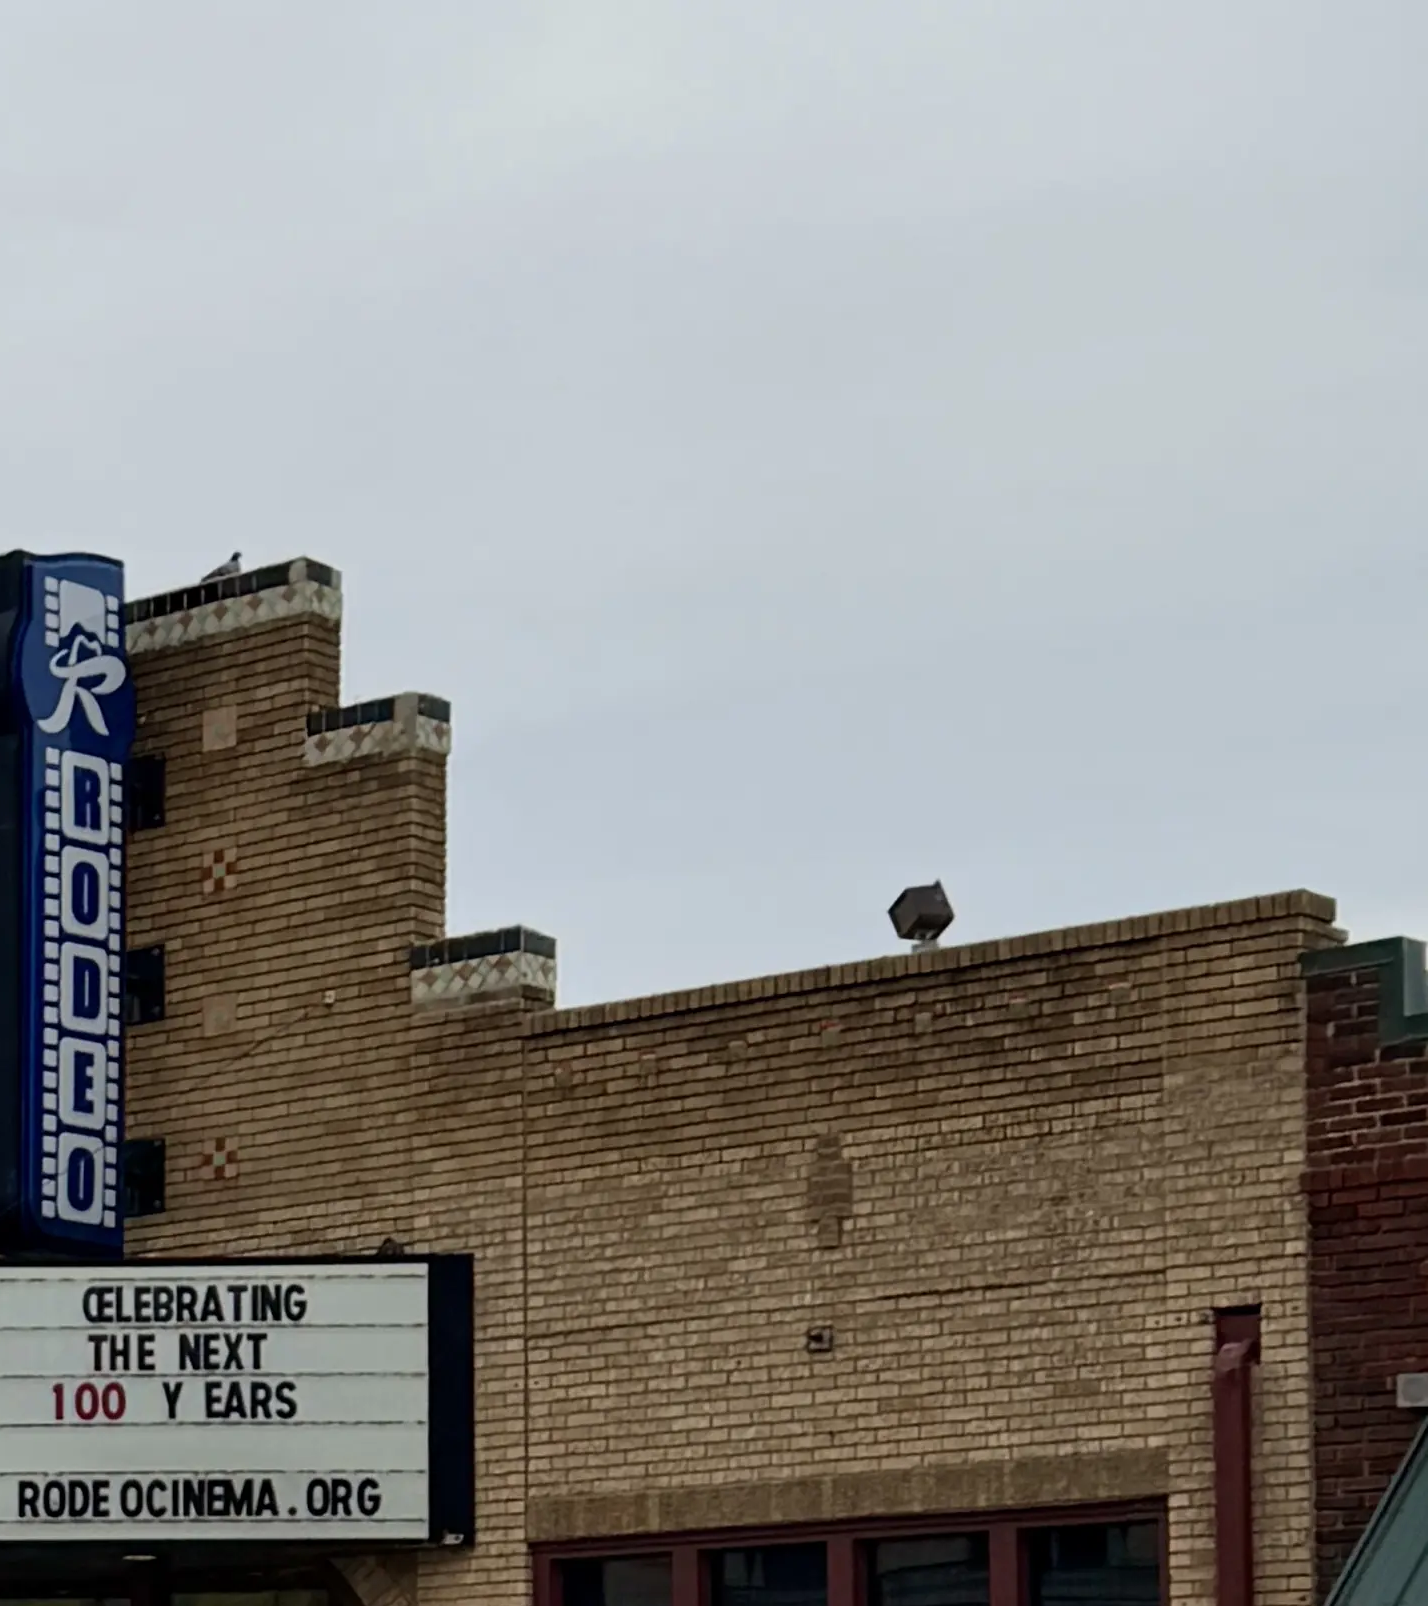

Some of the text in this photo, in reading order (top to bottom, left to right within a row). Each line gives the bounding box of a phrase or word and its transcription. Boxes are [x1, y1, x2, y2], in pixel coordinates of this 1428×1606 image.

[67, 764, 103, 1224] RODEO
[83, 1284, 308, 1324] CELEBRATING
[88, 1333, 268, 1372] THE NEXT
[52, 1383, 126, 1420] 100
[18, 1478, 382, 1518] RODEOCINEMA.ORG
